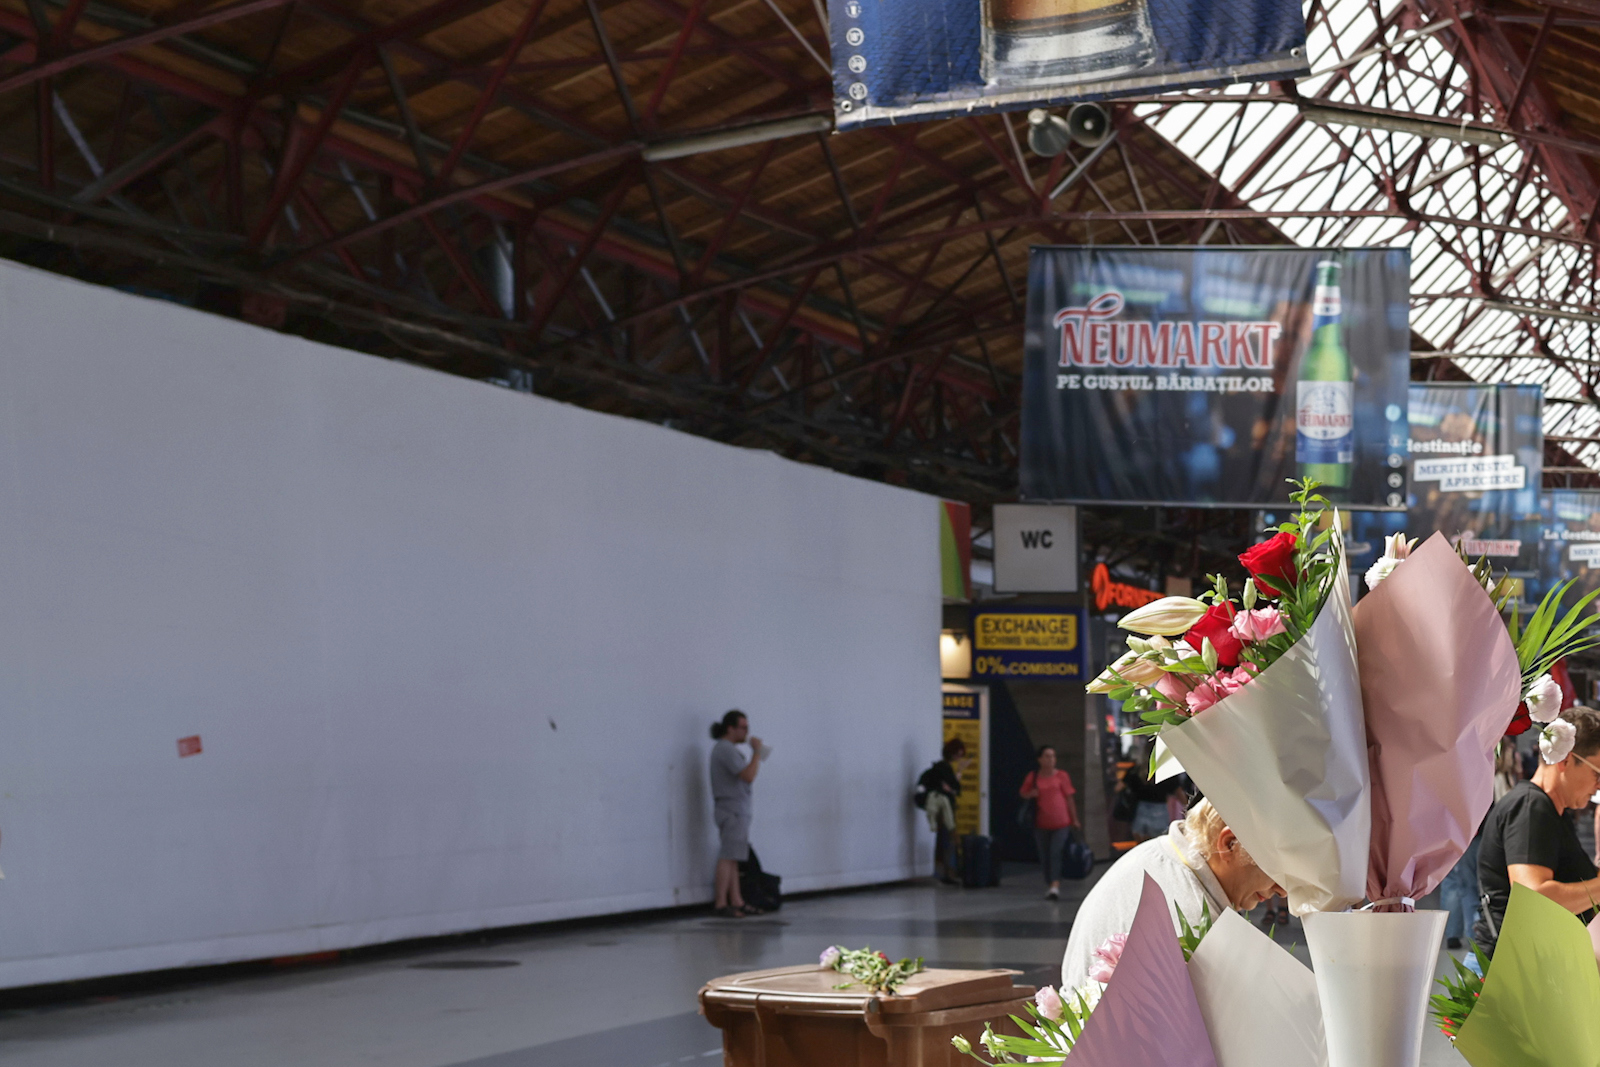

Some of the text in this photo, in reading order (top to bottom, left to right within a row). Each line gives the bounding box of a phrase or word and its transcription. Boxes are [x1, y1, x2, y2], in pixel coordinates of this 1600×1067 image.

[1053, 291, 1281, 368] NEUMARKT
[1056, 375, 1080, 390] PE
[1083, 375, 1153, 391] GUSTUL
[1021, 530, 1053, 549] WC
[982, 618, 1069, 634] EXCHANGE
[975, 656, 1006, 674] 0%
